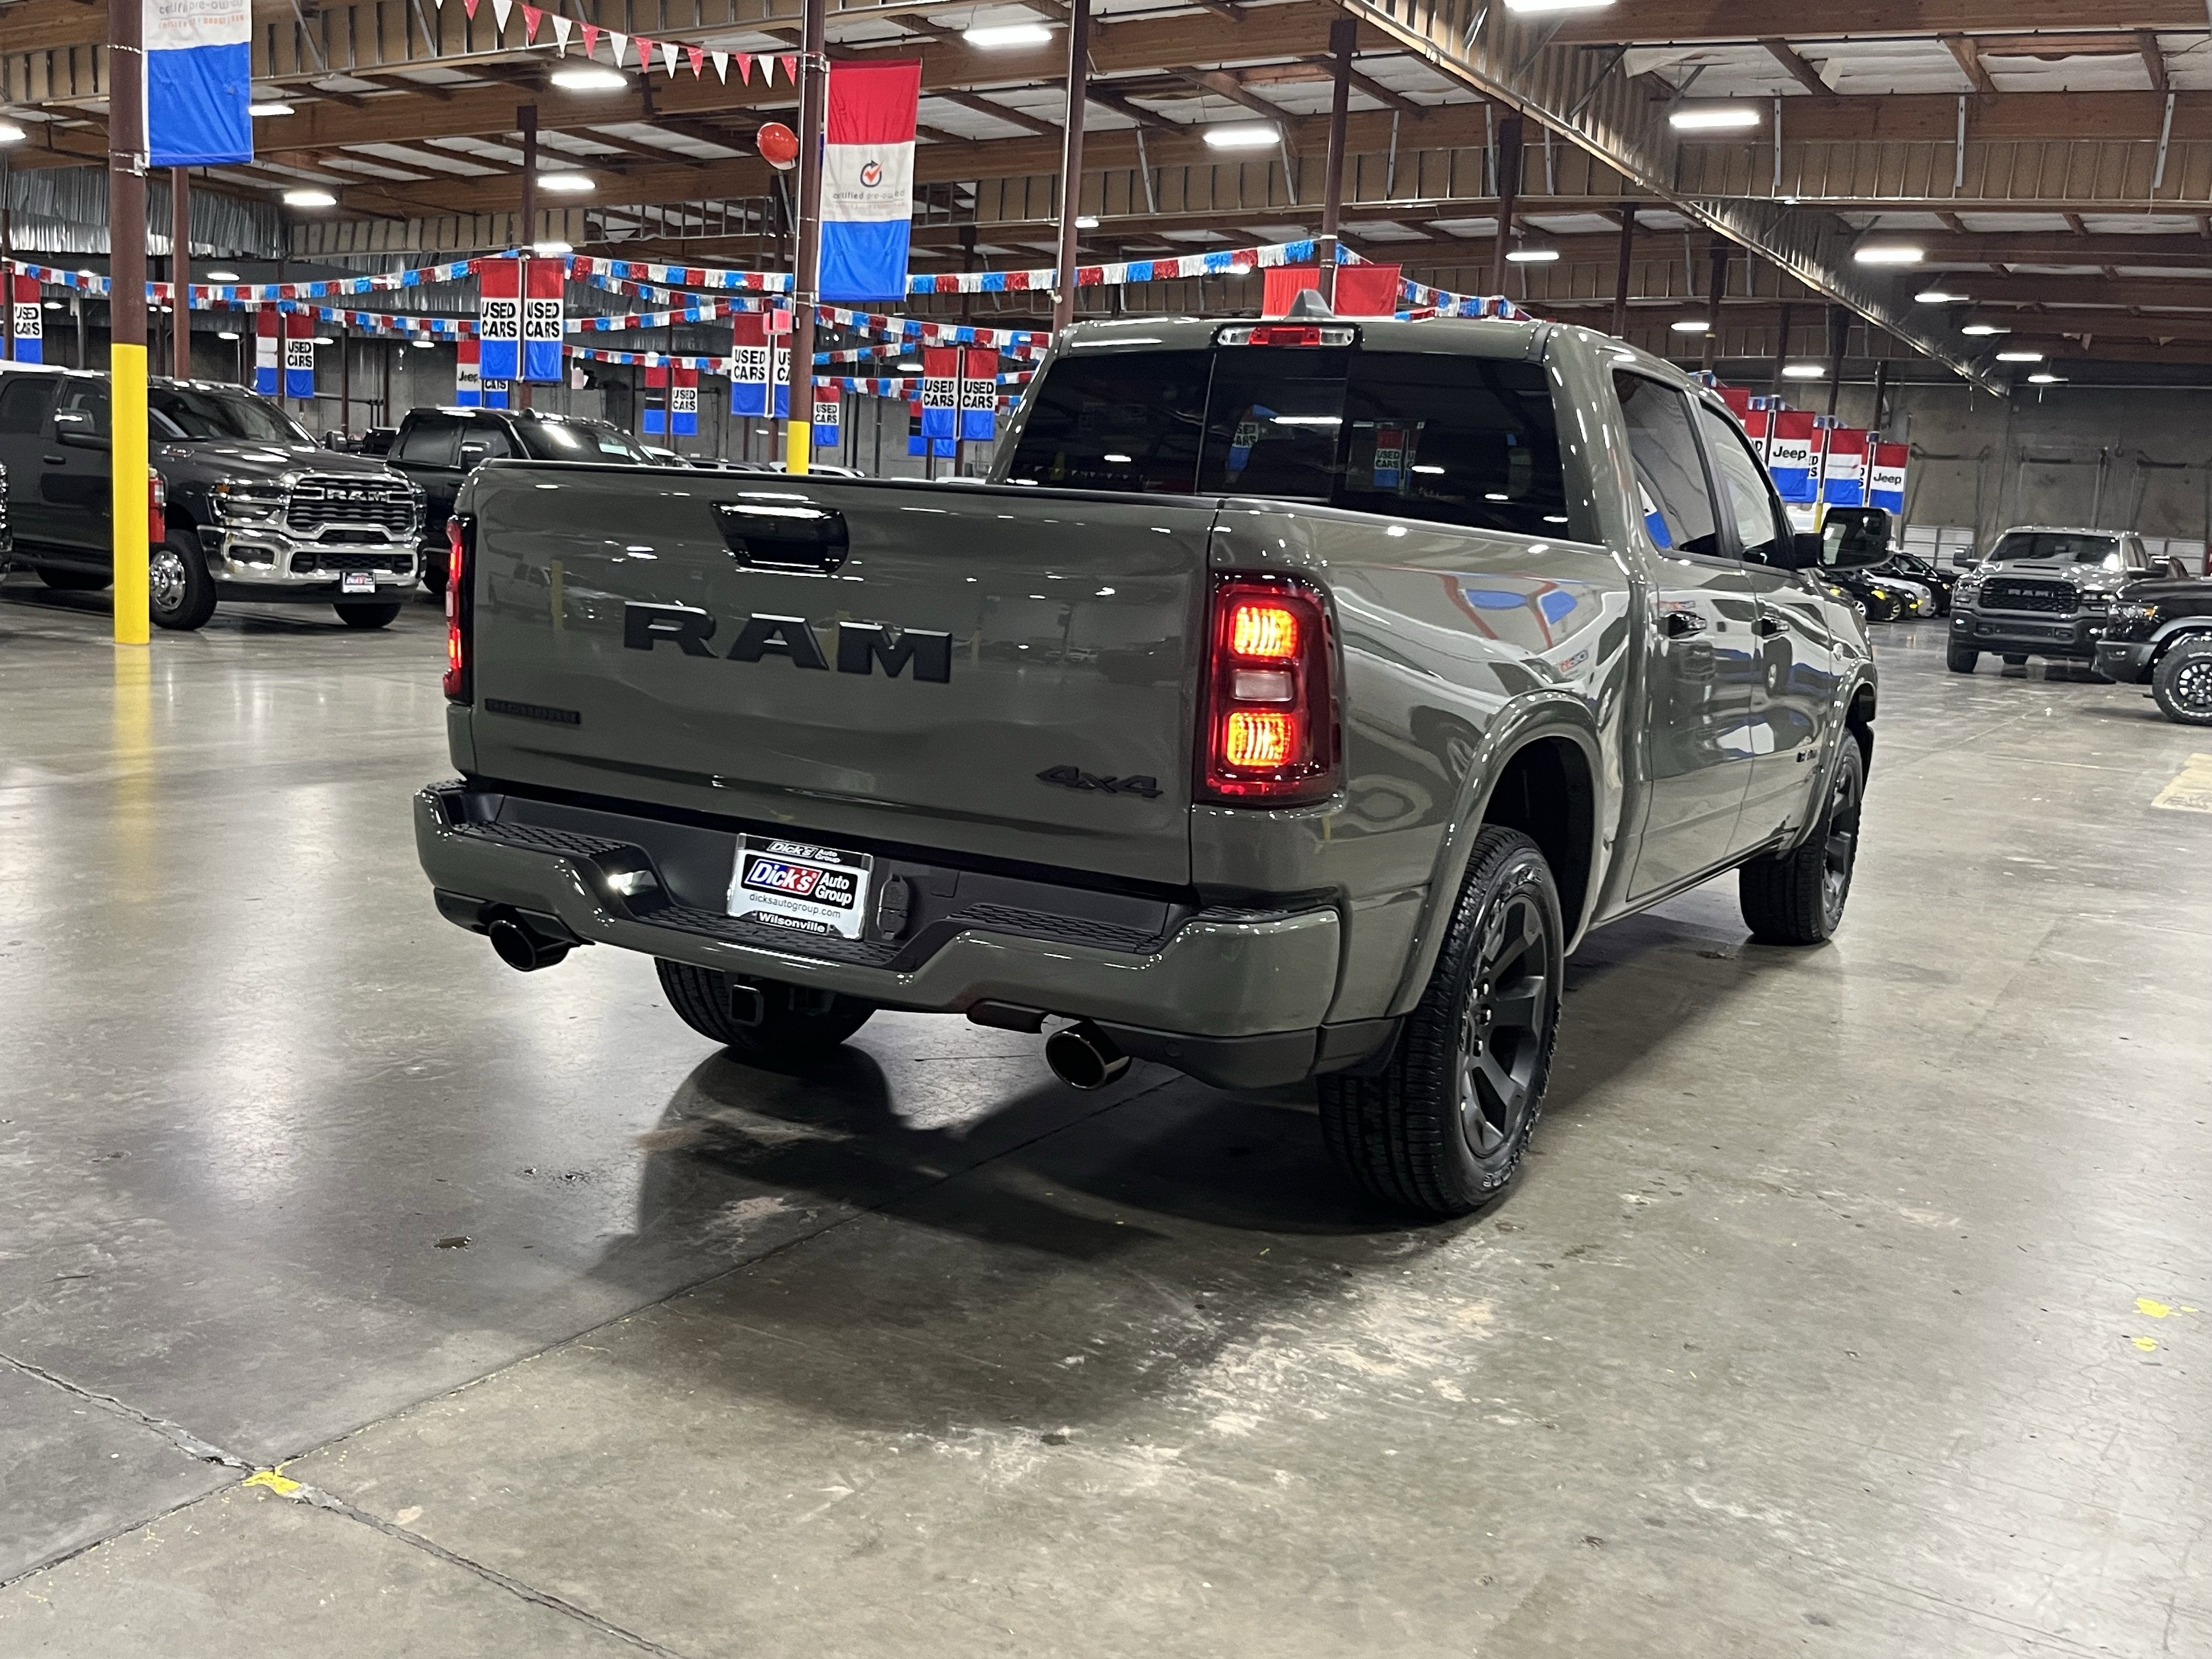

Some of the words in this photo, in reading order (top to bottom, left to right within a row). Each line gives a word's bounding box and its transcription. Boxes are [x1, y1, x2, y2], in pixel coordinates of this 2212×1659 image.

[482, 302, 516, 319] USED
[527, 302, 560, 319] USED
[482, 320, 517, 337] CARS
[526, 320, 560, 338] CARS
[288, 341, 312, 353] USED
[735, 349, 765, 364] USED
[734, 365, 765, 380] CARS
[924, 379, 954, 393] USED
[964, 381, 994, 394] USED
[673, 390, 696, 400] USED
[924, 393, 954, 407] CARS
[962, 395, 994, 408] CARS
[816, 404, 837, 413] USED
[815, 414, 837, 423] CARS
[1376, 451, 1400, 459] USED
[1773, 446, 1807, 460] Jeep
[1874, 473, 1901, 485] Jeep
[327, 489, 387, 501] RAM
[624, 601, 952, 684] RAM
[769, 842, 815, 856] Dick's
[817, 849, 838, 857] Auto
[815, 854, 842, 864] Group
[750, 861, 813, 892] Dick's
[819, 872, 850, 890] Auto
[815, 885, 853, 906] Group
[749, 893, 841, 918] dicksautogroup.com
[759, 912, 826, 933] Wilsonville
